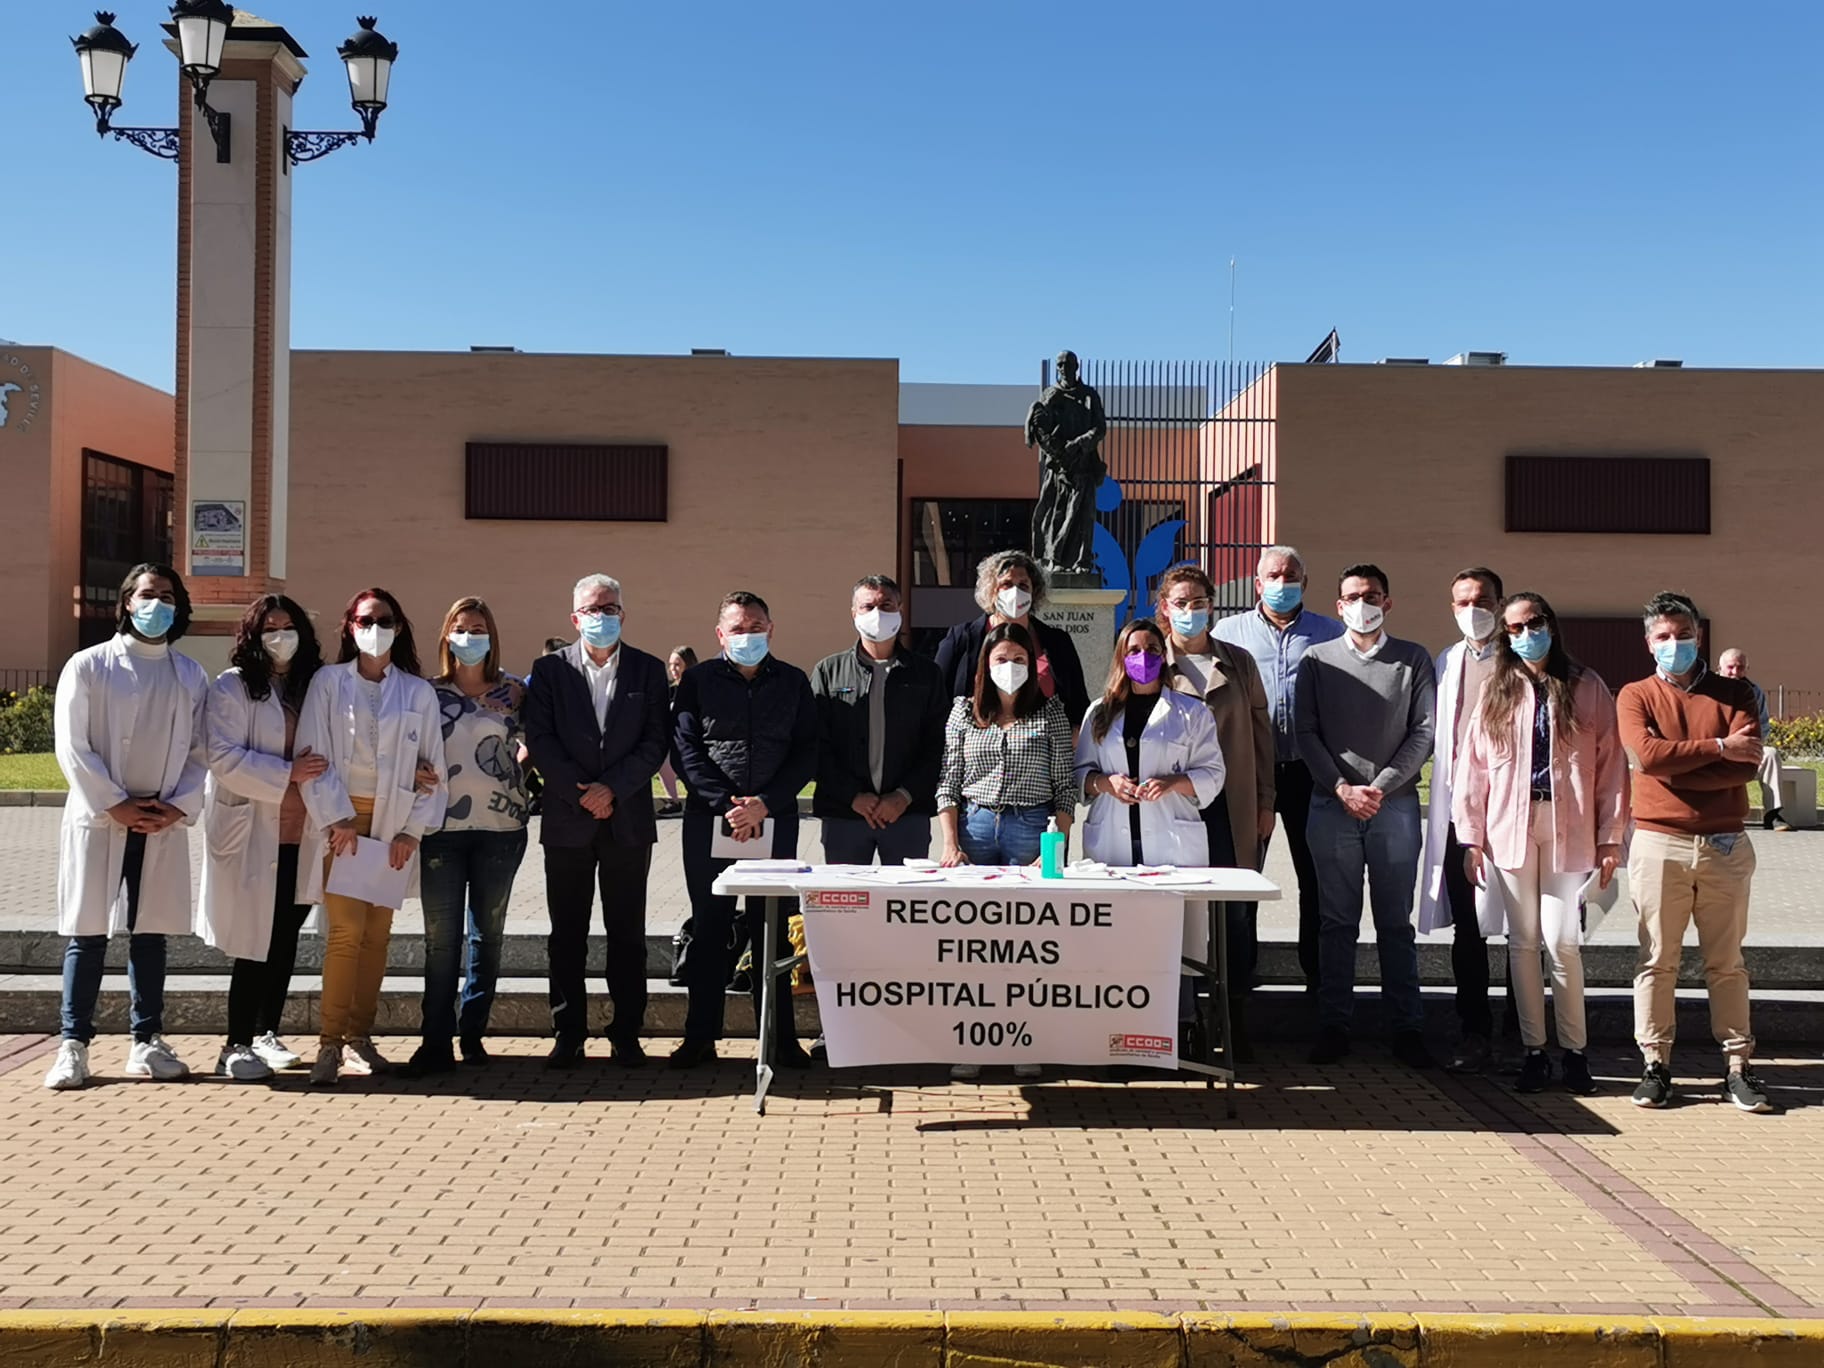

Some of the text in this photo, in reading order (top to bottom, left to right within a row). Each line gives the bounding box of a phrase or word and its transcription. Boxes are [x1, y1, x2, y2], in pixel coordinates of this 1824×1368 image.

[1042, 611, 1095, 622] SAN JUAN
[1065, 624, 1090, 634] DIOS
[822, 893, 858, 903] CCOO
[886, 899, 1113, 927] RECOGIDA DE
[937, 938, 1060, 965] FIRMAS
[836, 977, 1150, 1009] HOSPITAL PÚBLICO
[952, 1021, 1033, 1047] 100%
[1126, 1037, 1162, 1048] CCOO
